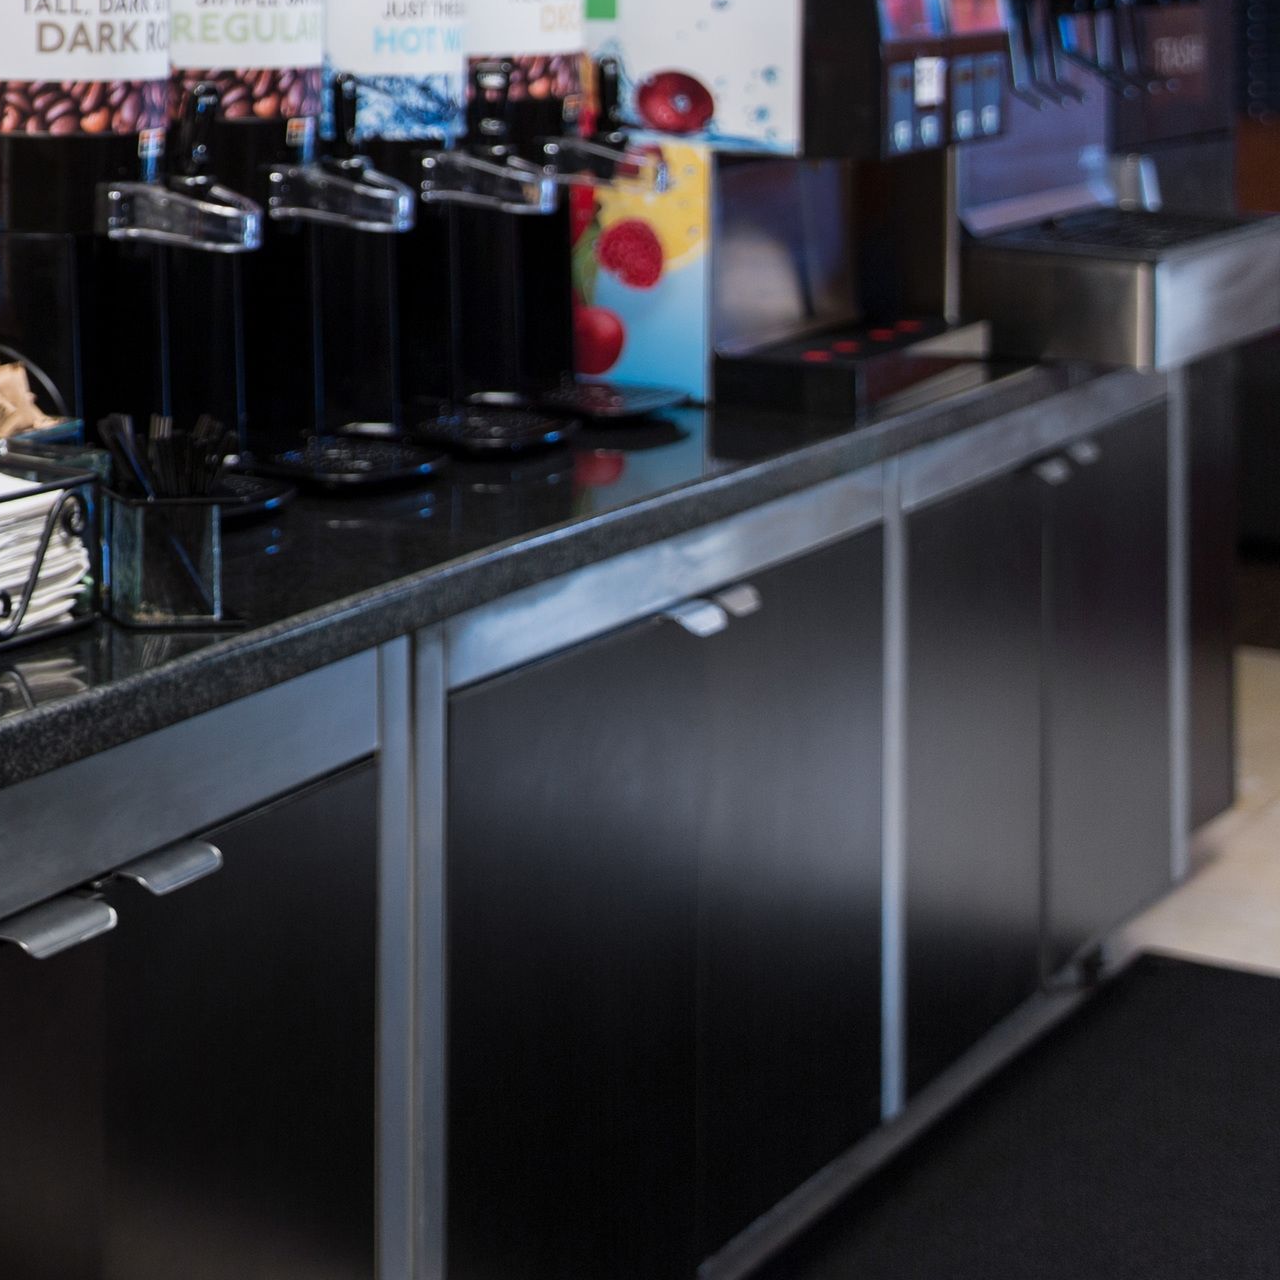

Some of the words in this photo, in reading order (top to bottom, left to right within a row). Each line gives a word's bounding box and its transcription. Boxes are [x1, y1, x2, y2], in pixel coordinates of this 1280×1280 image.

[383, 0, 426, 19] JUST
[37, 21, 139, 54] DARK
[373, 26, 436, 54] HOT
